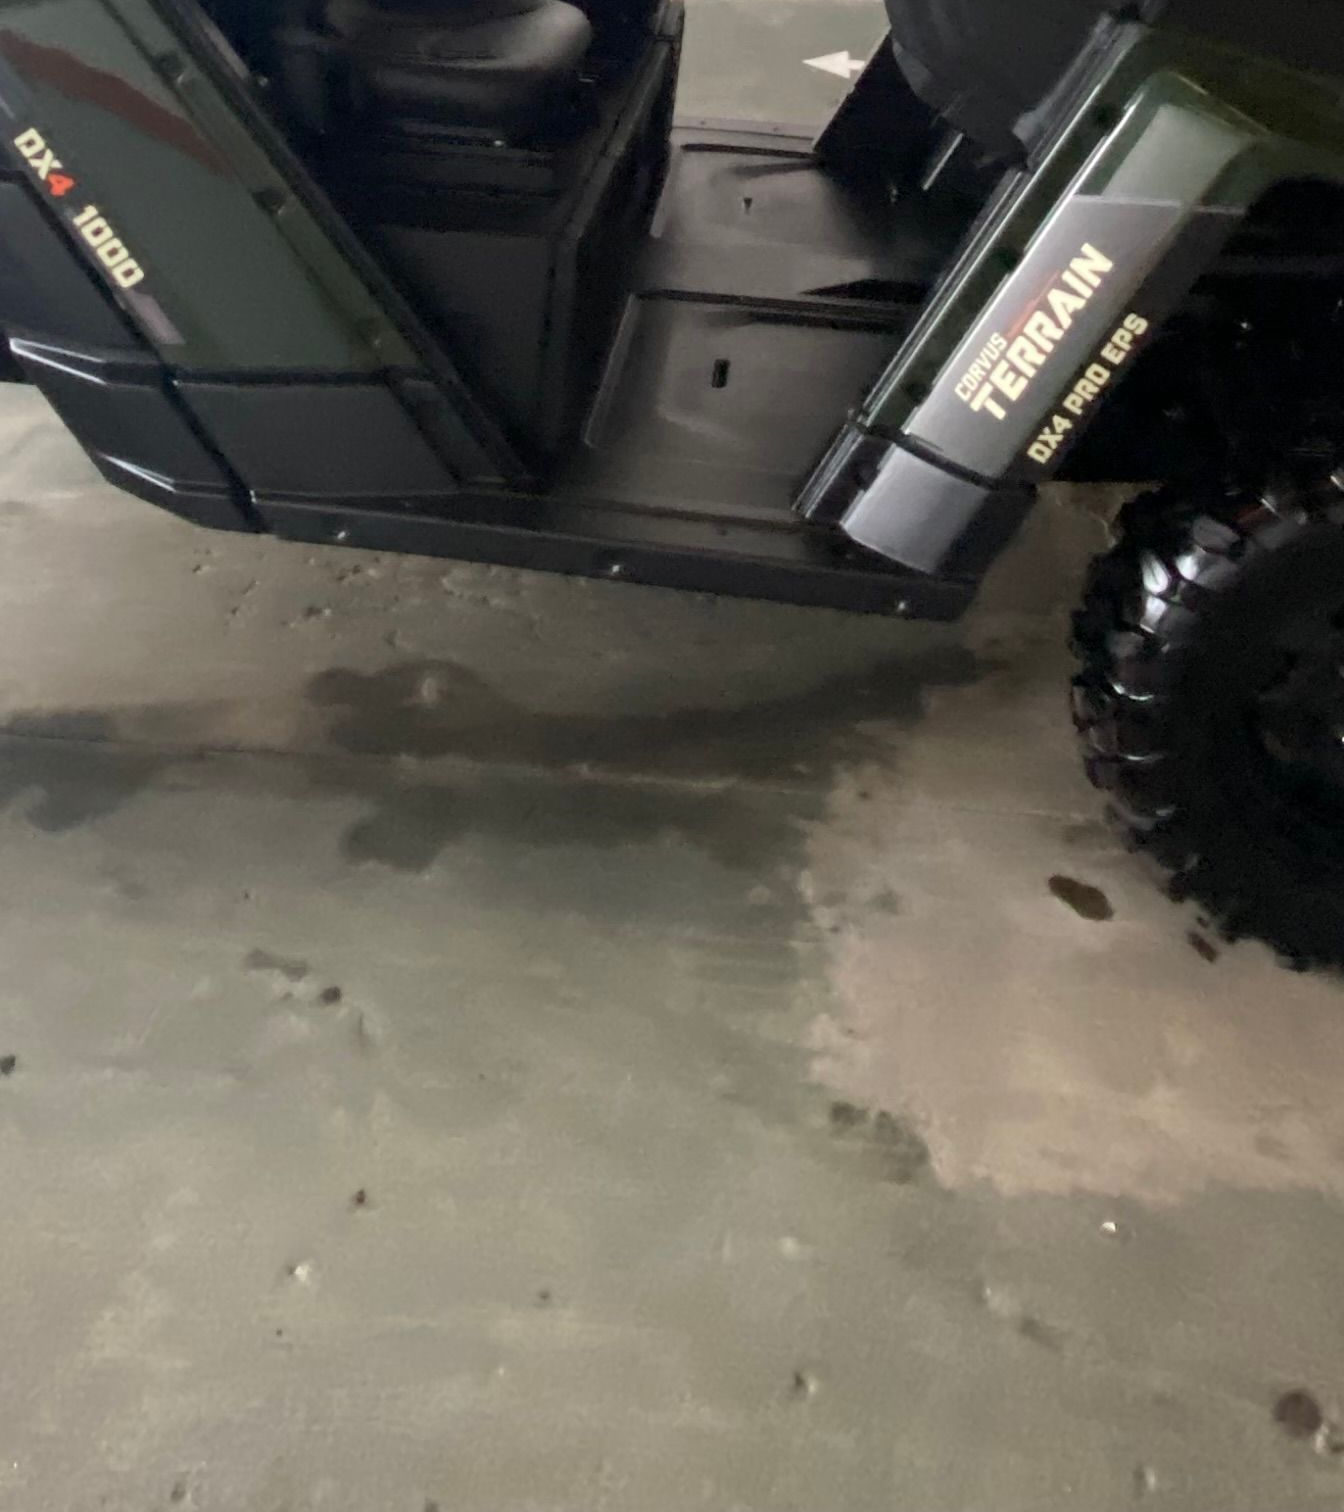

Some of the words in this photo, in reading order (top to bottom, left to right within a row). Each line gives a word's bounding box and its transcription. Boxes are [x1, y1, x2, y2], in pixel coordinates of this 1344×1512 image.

[14, 128, 75, 196] DX4
[73, 205, 144, 288] 1000
[955, 333, 1007, 401] CORVUS
[970, 243, 1113, 420] TERRAIN
[1027, 414, 1072, 464] DX4
[1063, 364, 1110, 415] PRO
[1101, 313, 1149, 364] EPS
